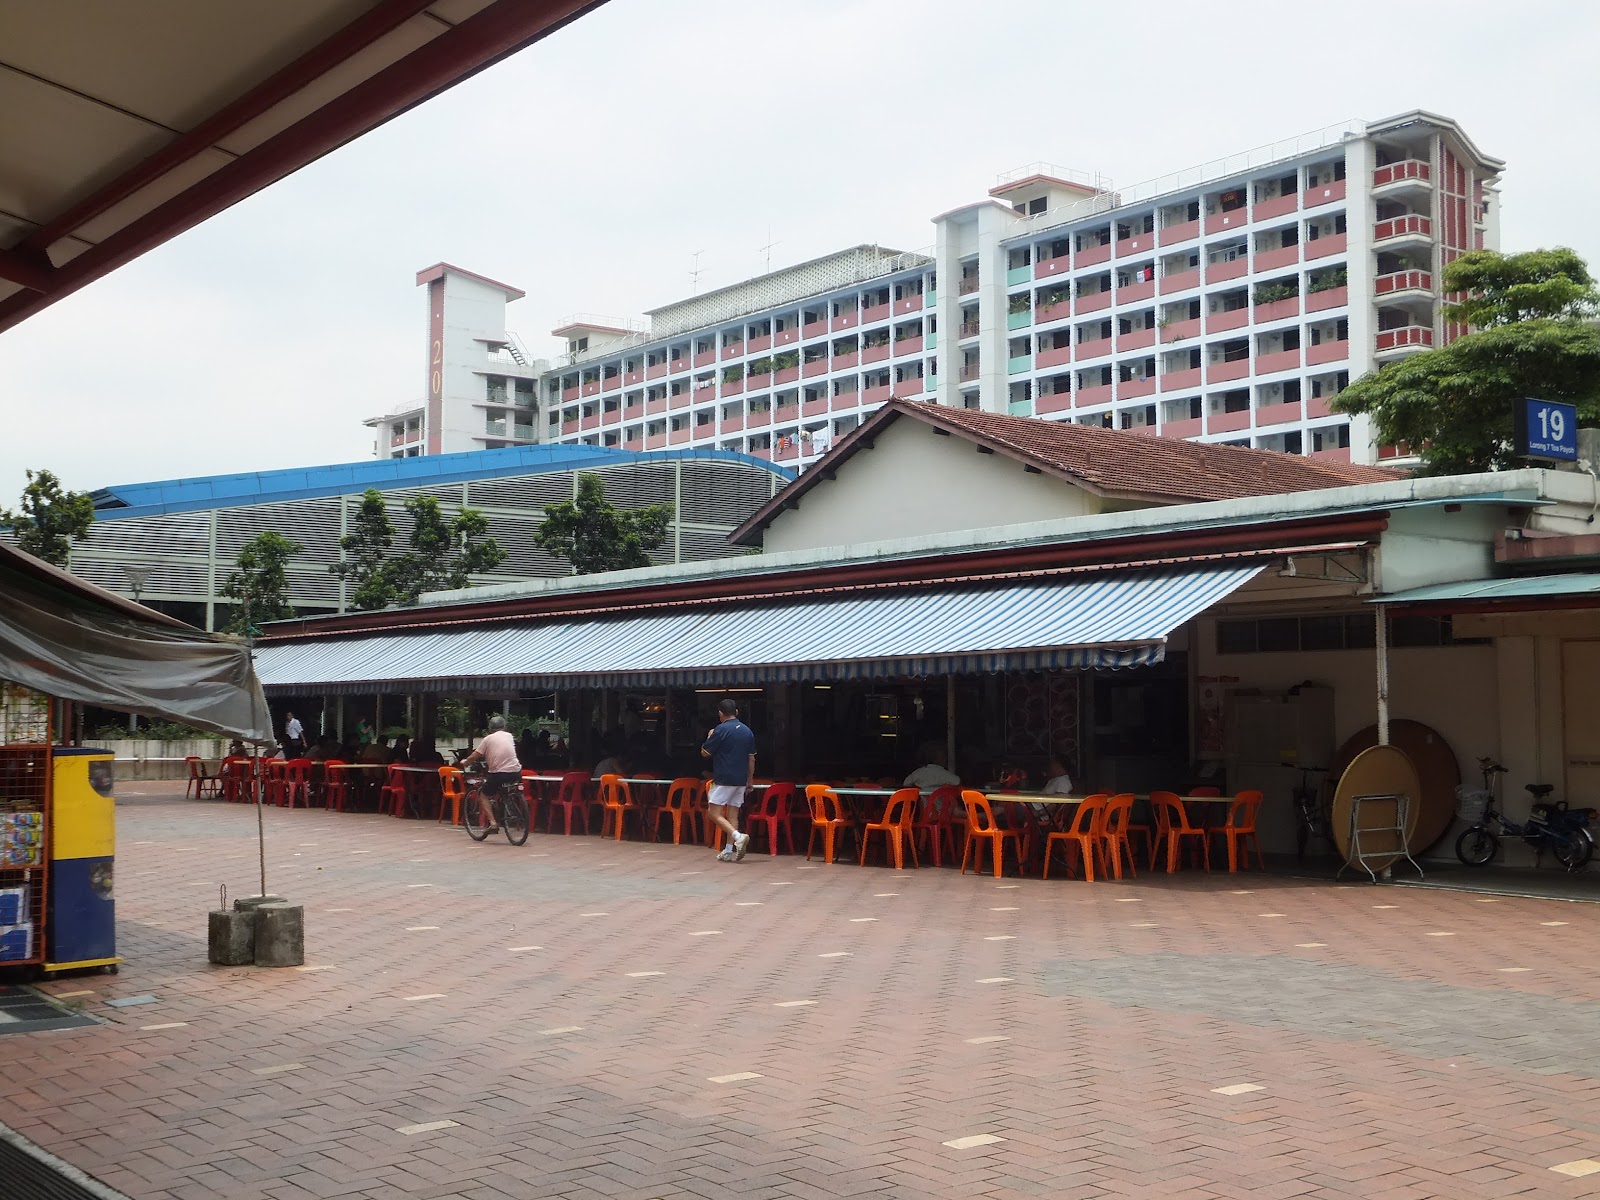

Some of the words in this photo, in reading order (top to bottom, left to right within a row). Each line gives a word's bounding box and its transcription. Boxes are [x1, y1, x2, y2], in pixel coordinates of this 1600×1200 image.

[432, 339, 441, 395] 20
[1537, 408, 1565, 441] 19
[1529, 441, 1547, 452] Lorong
[1550, 443, 1560, 452] Toa
[1559, 445, 1575, 454] Payoh
